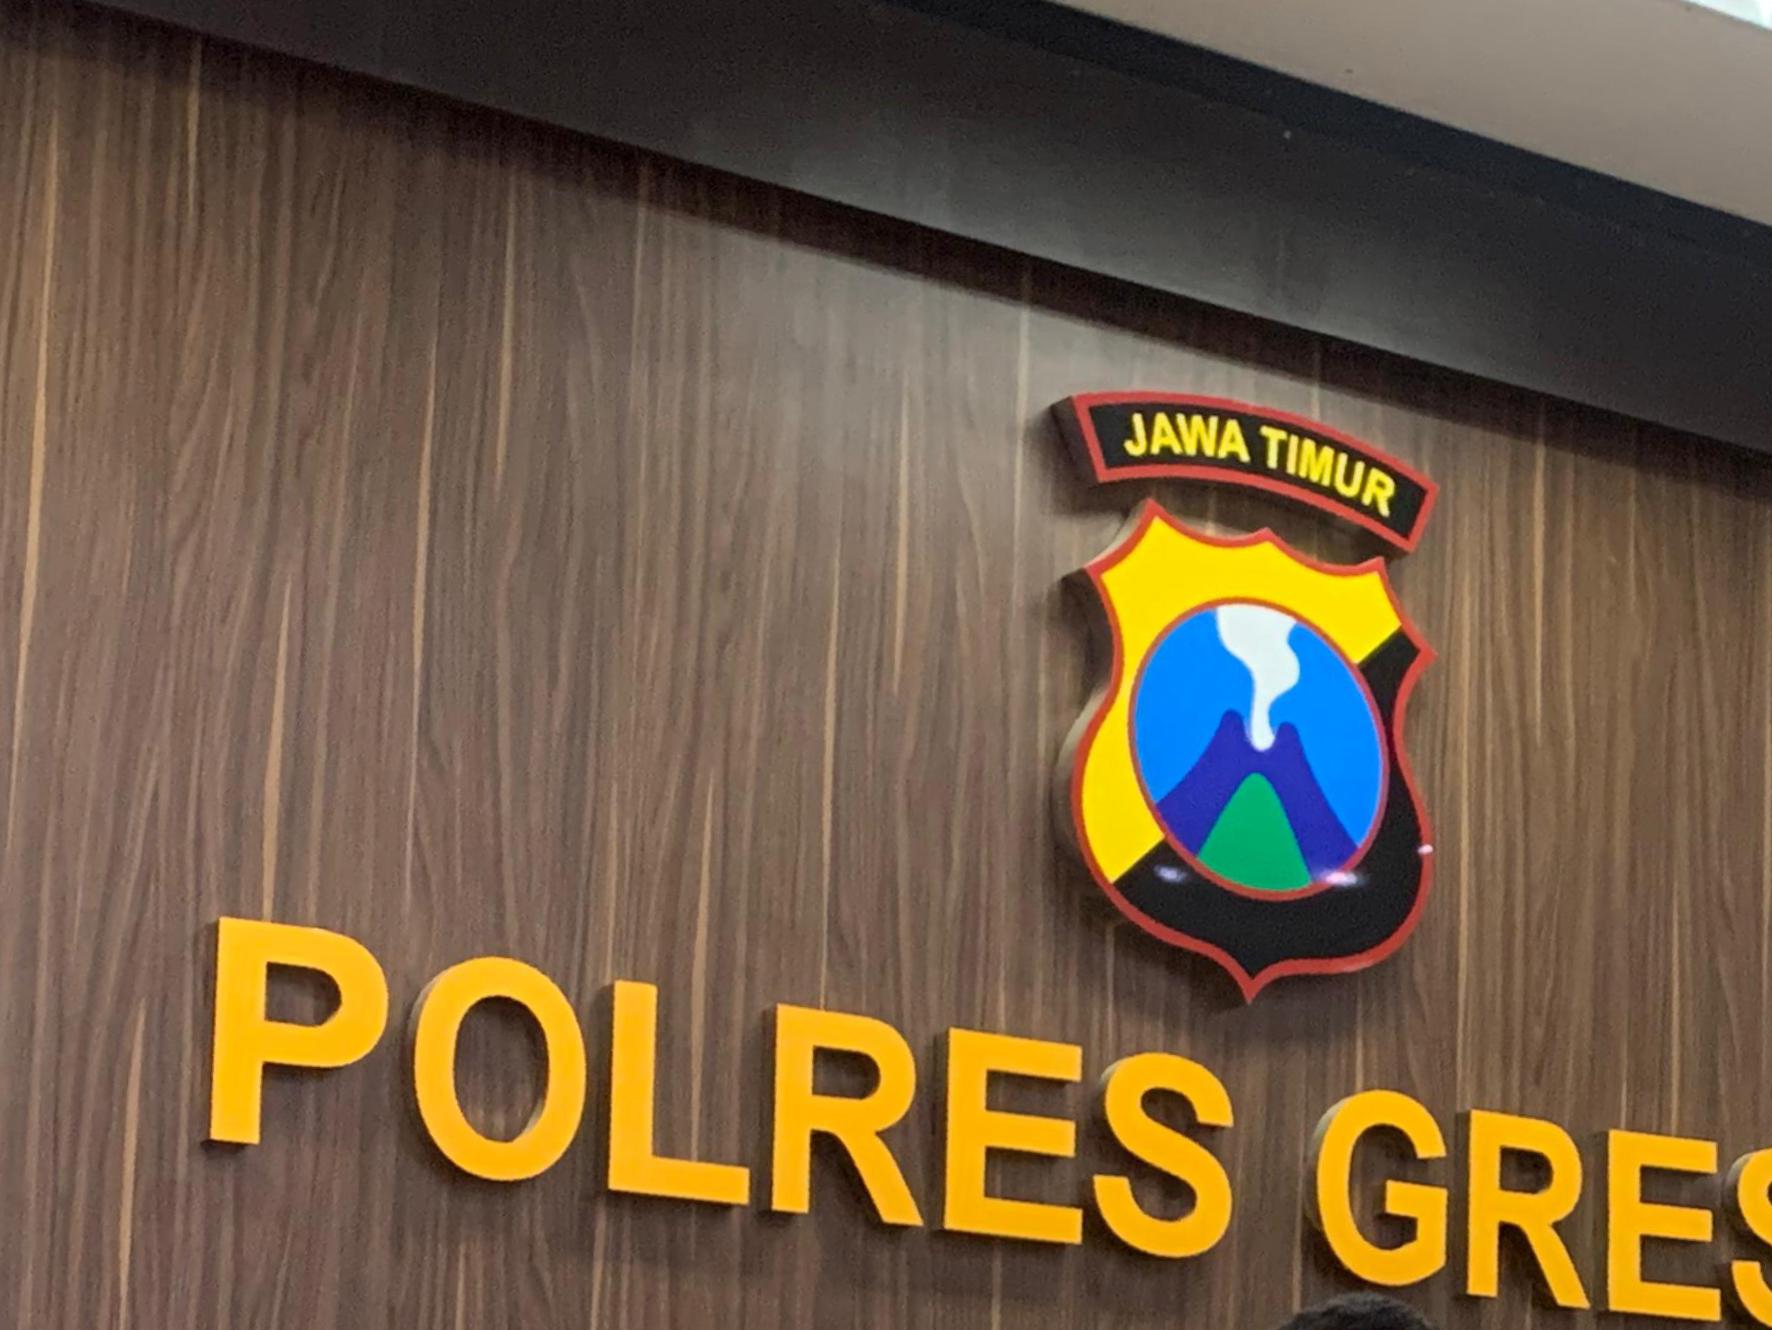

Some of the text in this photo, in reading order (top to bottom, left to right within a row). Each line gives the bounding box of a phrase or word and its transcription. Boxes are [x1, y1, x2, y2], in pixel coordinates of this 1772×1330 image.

[1123, 412, 1396, 517] JAWA TIMUR
[207, 915, 1234, 1259] POLRES
